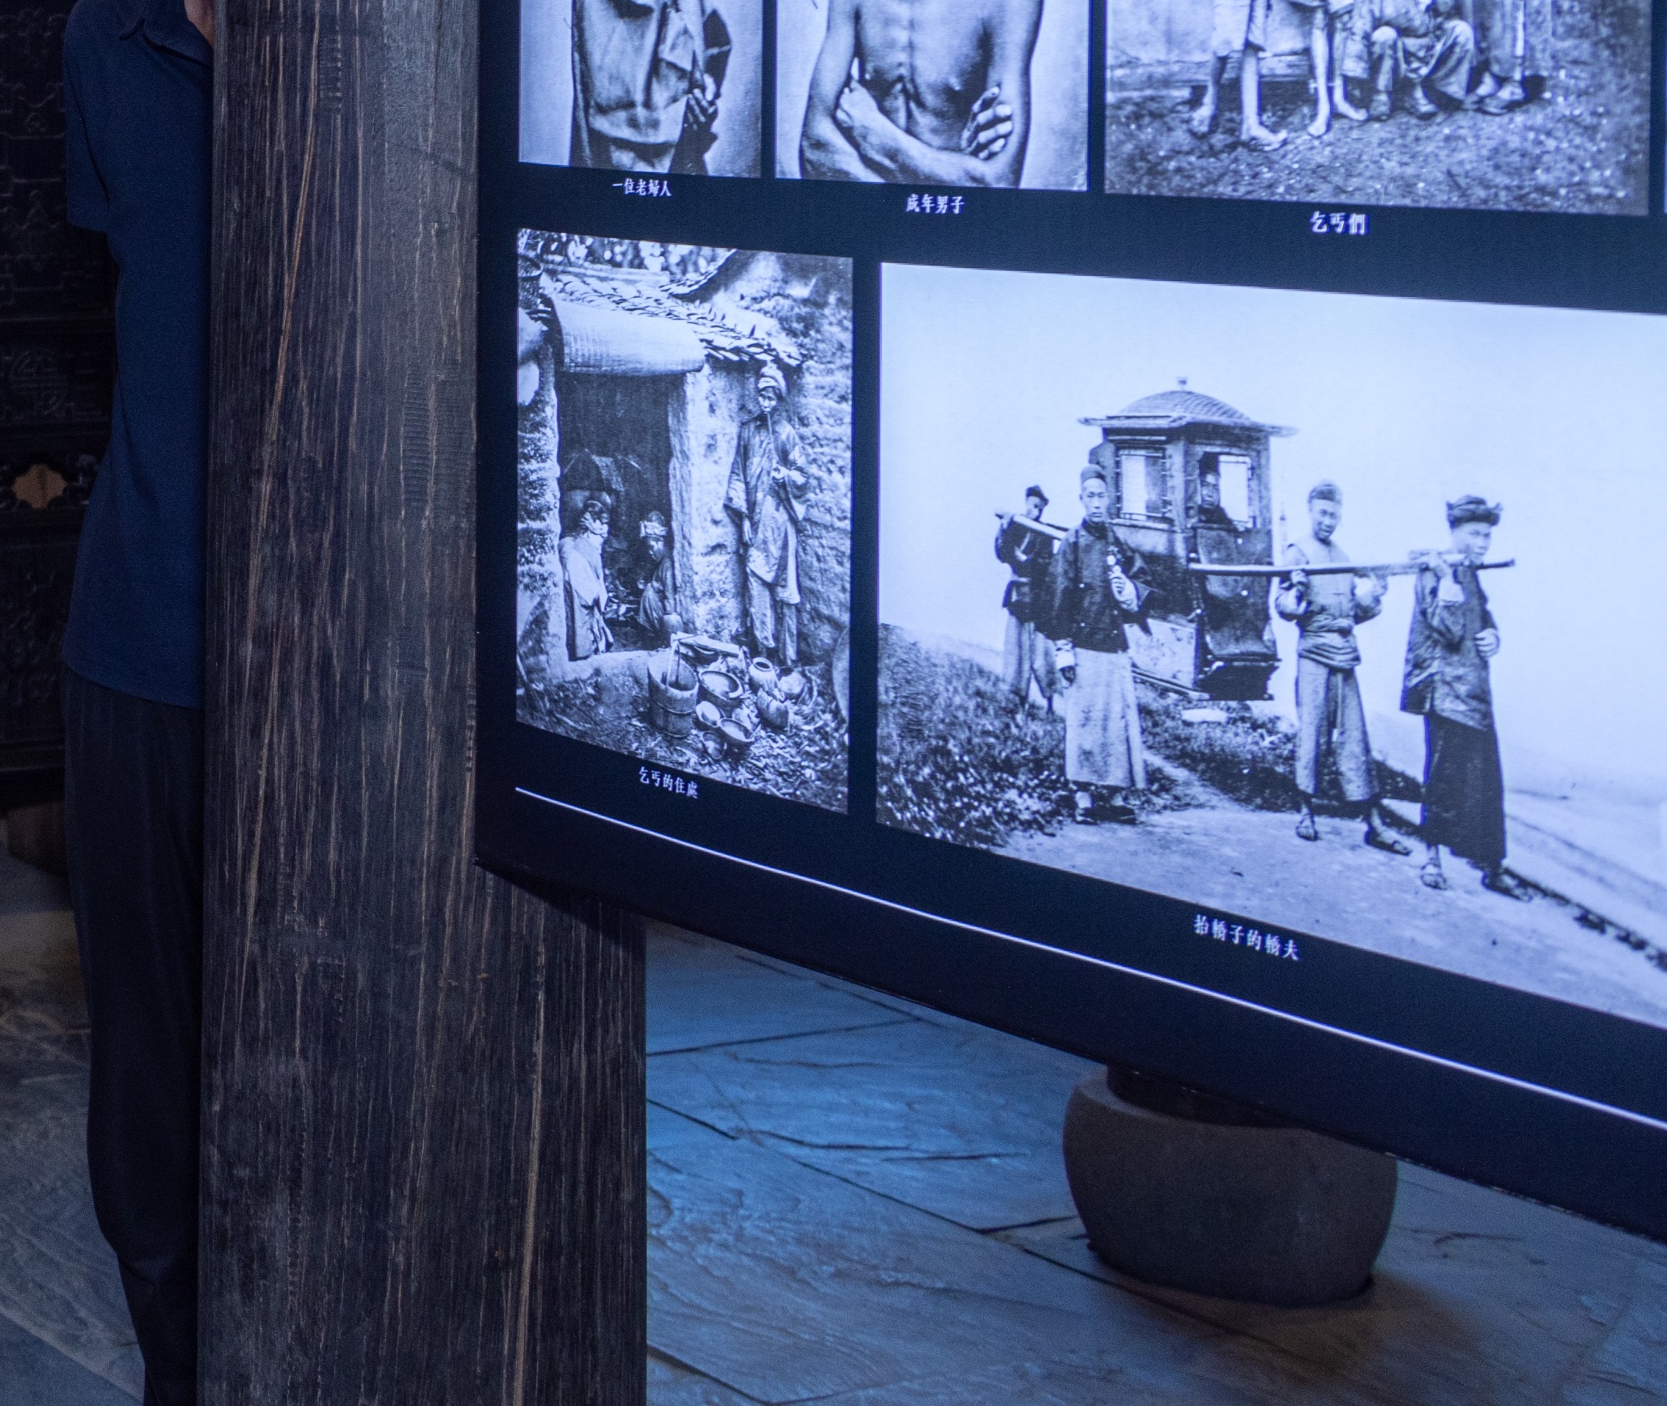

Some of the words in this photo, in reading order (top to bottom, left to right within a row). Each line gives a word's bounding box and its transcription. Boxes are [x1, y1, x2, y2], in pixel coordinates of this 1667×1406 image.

[612, 178, 672, 197] 一位老婦人
[906, 193, 965, 214] 成年男子
[1310, 211, 1367, 235] 乞丐們
[639, 766, 699, 799] 乞丐的住處
